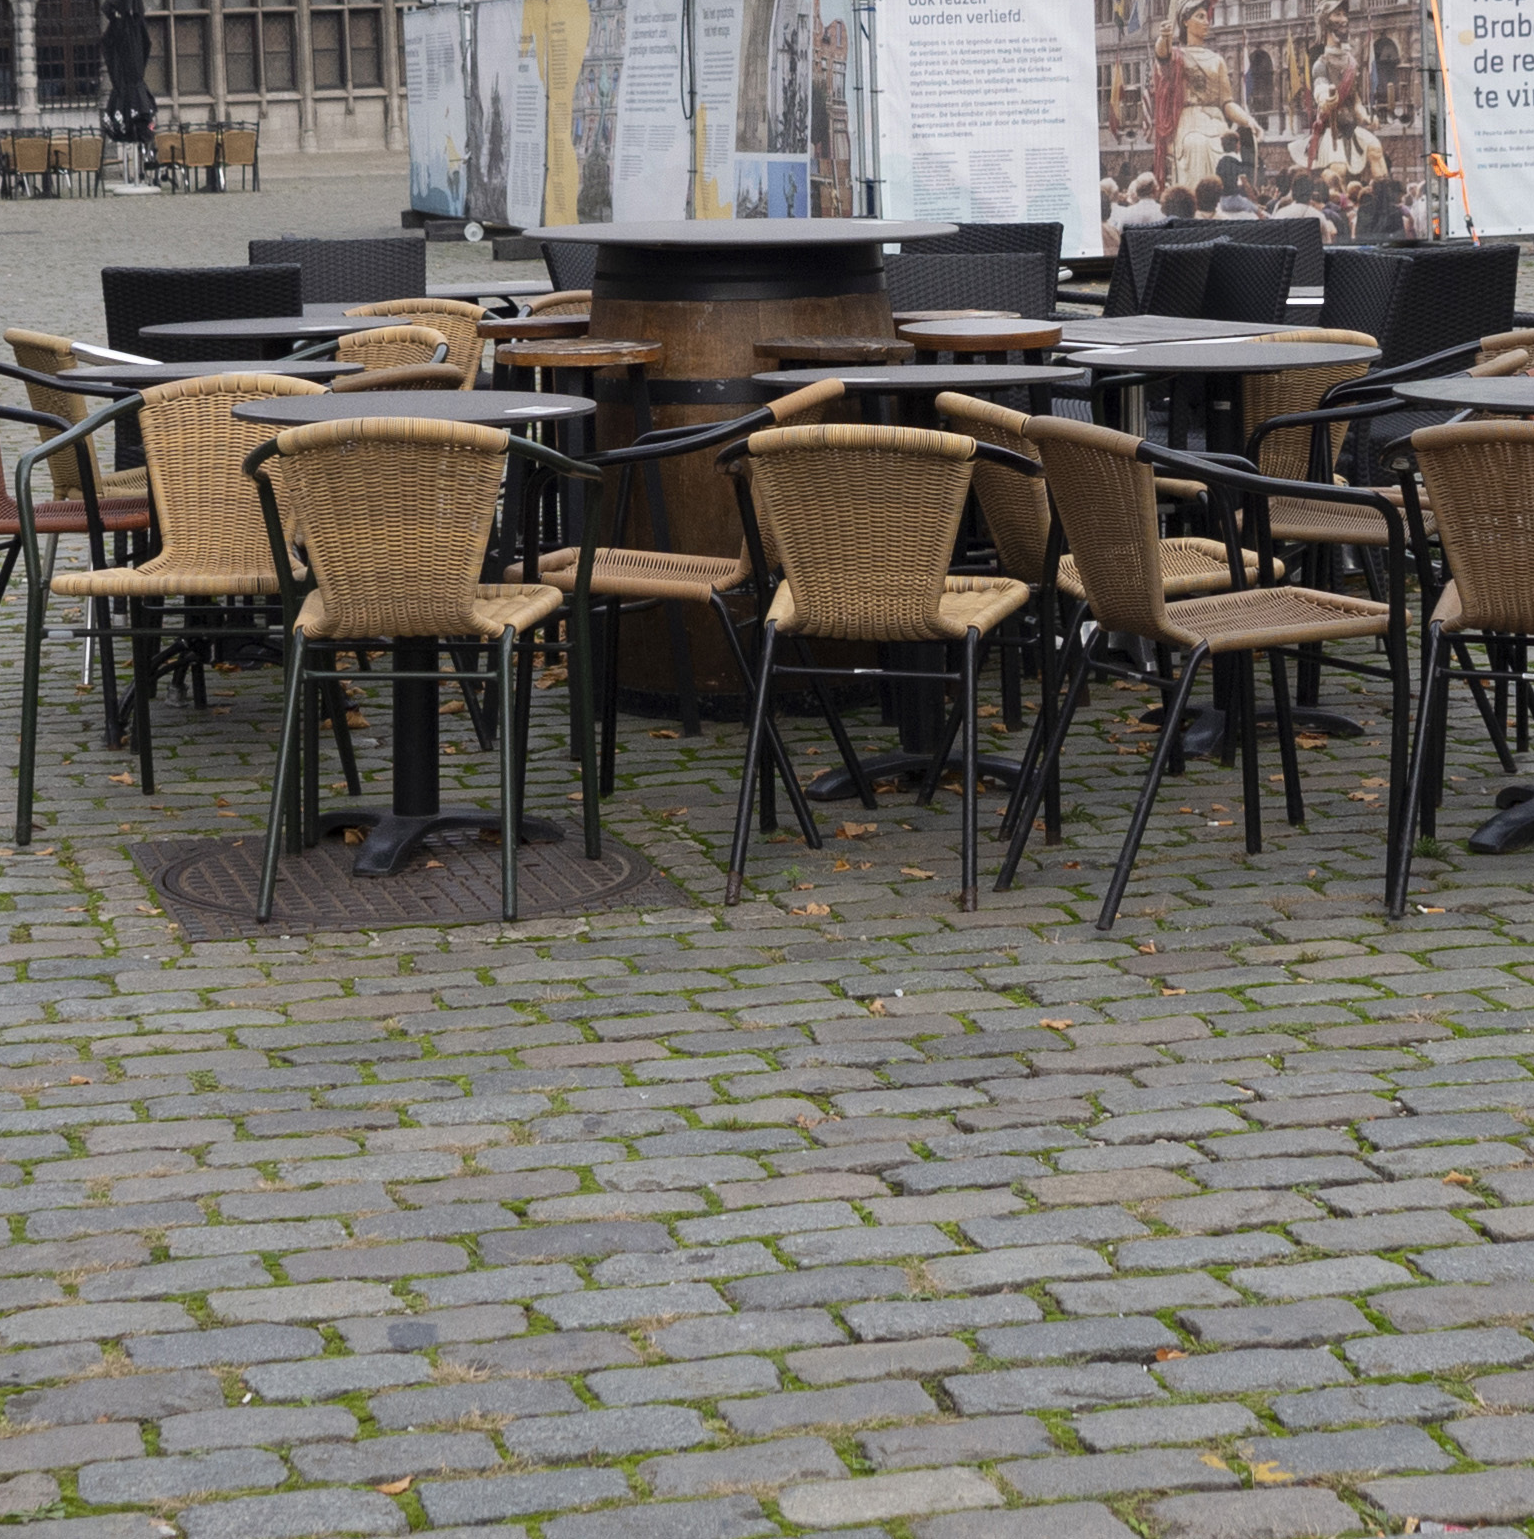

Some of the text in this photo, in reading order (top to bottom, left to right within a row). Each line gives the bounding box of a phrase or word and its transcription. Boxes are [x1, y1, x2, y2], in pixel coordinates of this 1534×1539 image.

[909, 9, 1025, 26] worden verliefd.
[909, 49, 917, 57] de
[959, 47, 996, 56] Antwerpen
[1023, 47, 1036, 55] nog
[1048, 45, 1062, 54] jaar
[950, 58, 958, 66] de
[1474, 49, 1504, 74] de
[951, 77, 974, 85] beiden
[1473, 86, 1499, 109] te
